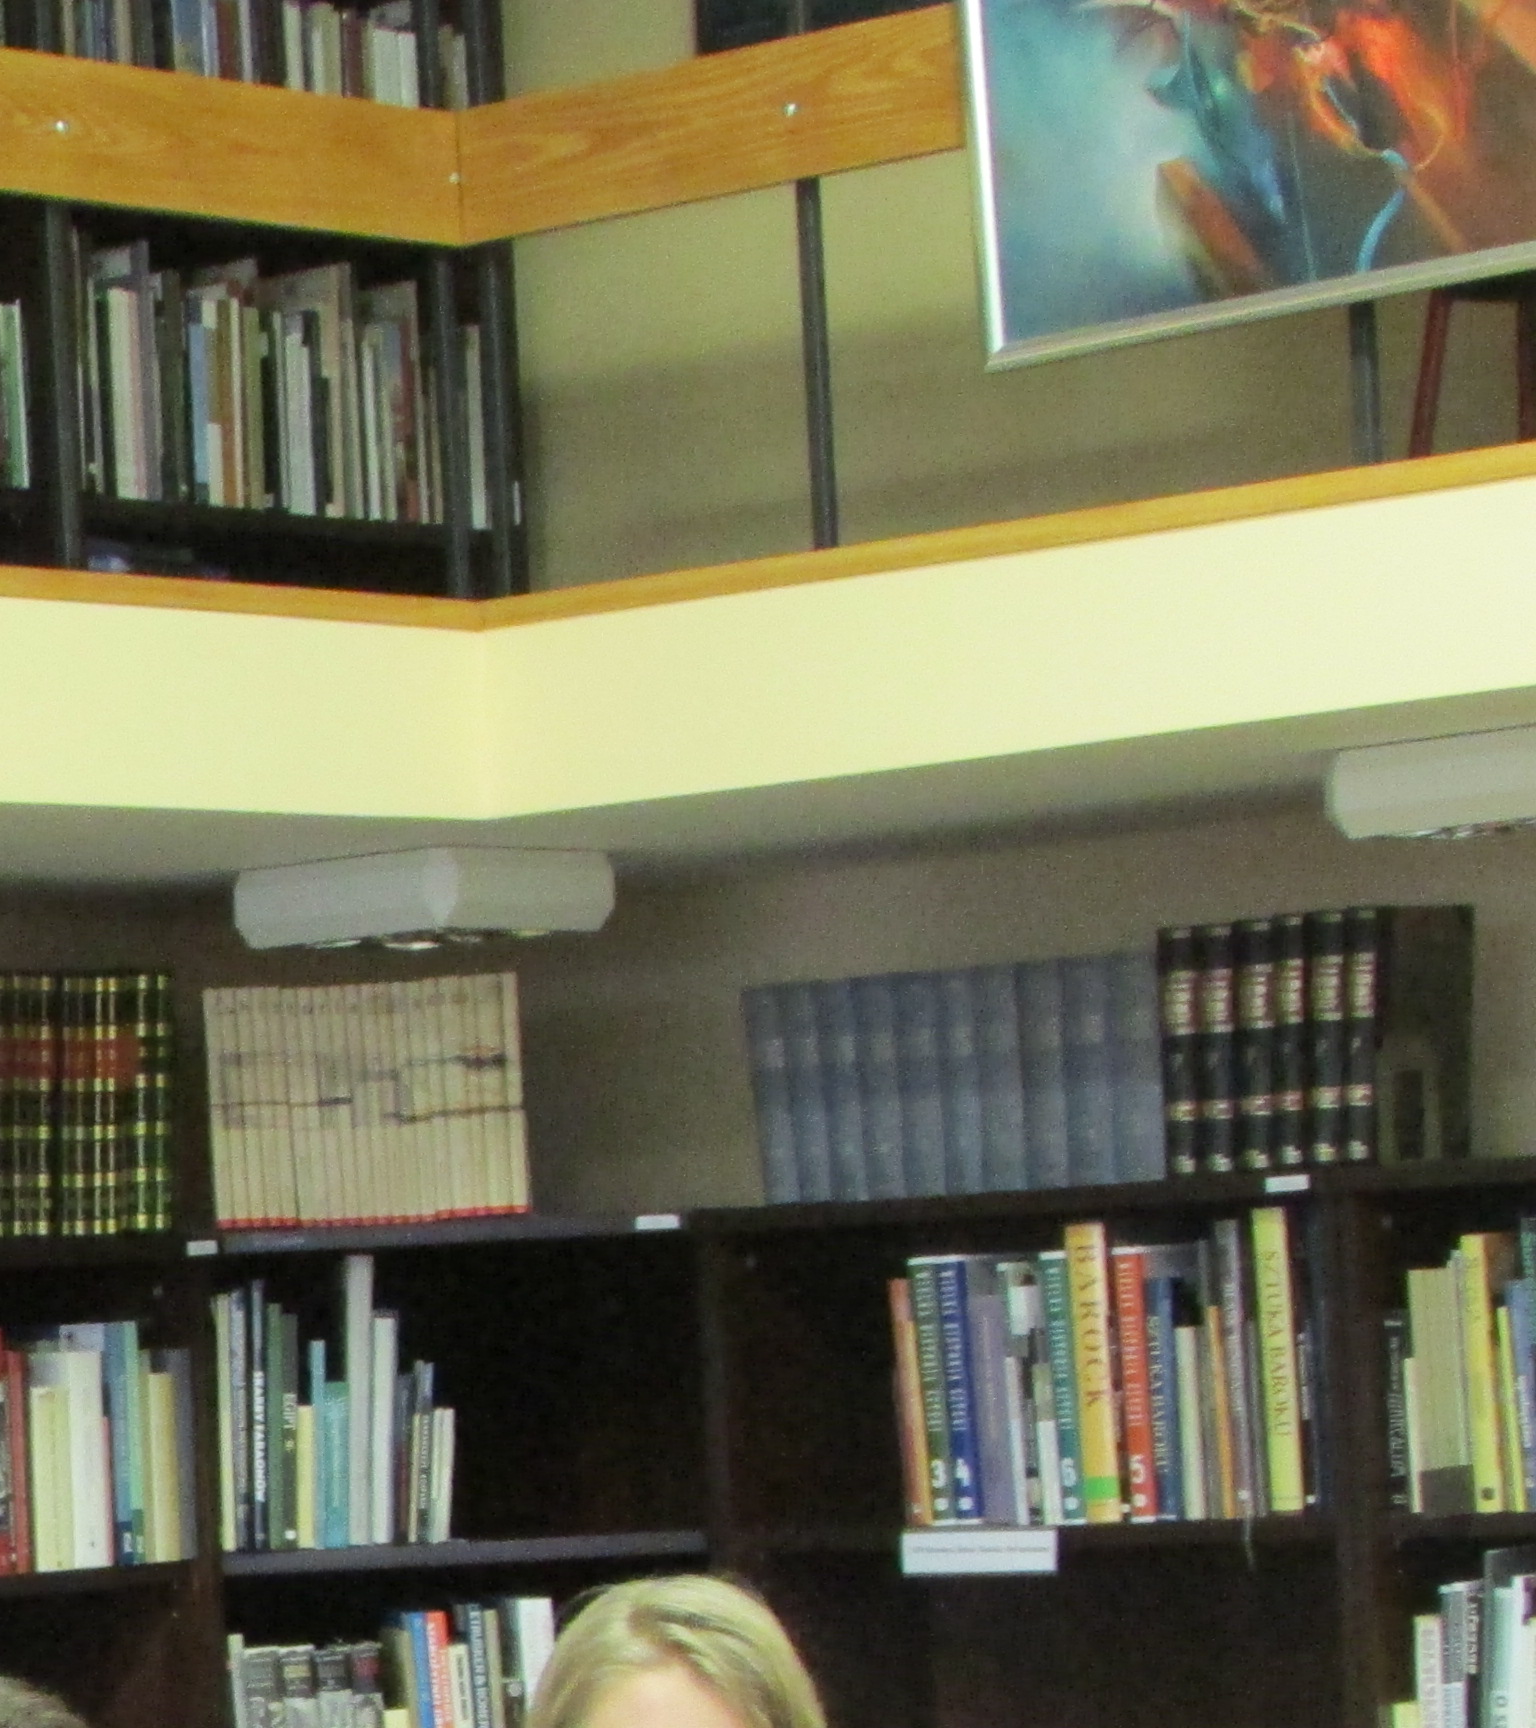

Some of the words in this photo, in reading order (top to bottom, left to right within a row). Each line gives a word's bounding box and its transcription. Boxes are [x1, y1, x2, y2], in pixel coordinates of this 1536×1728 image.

[1263, 1249, 1285, 1337] SZTUKA
[1270, 1346, 1290, 1437] BAROKU
[931, 1459, 946, 1488] 3
[955, 1458, 970, 1487] 4
[1061, 1458, 1078, 1487] 6
[1130, 1454, 1146, 1485] 5
